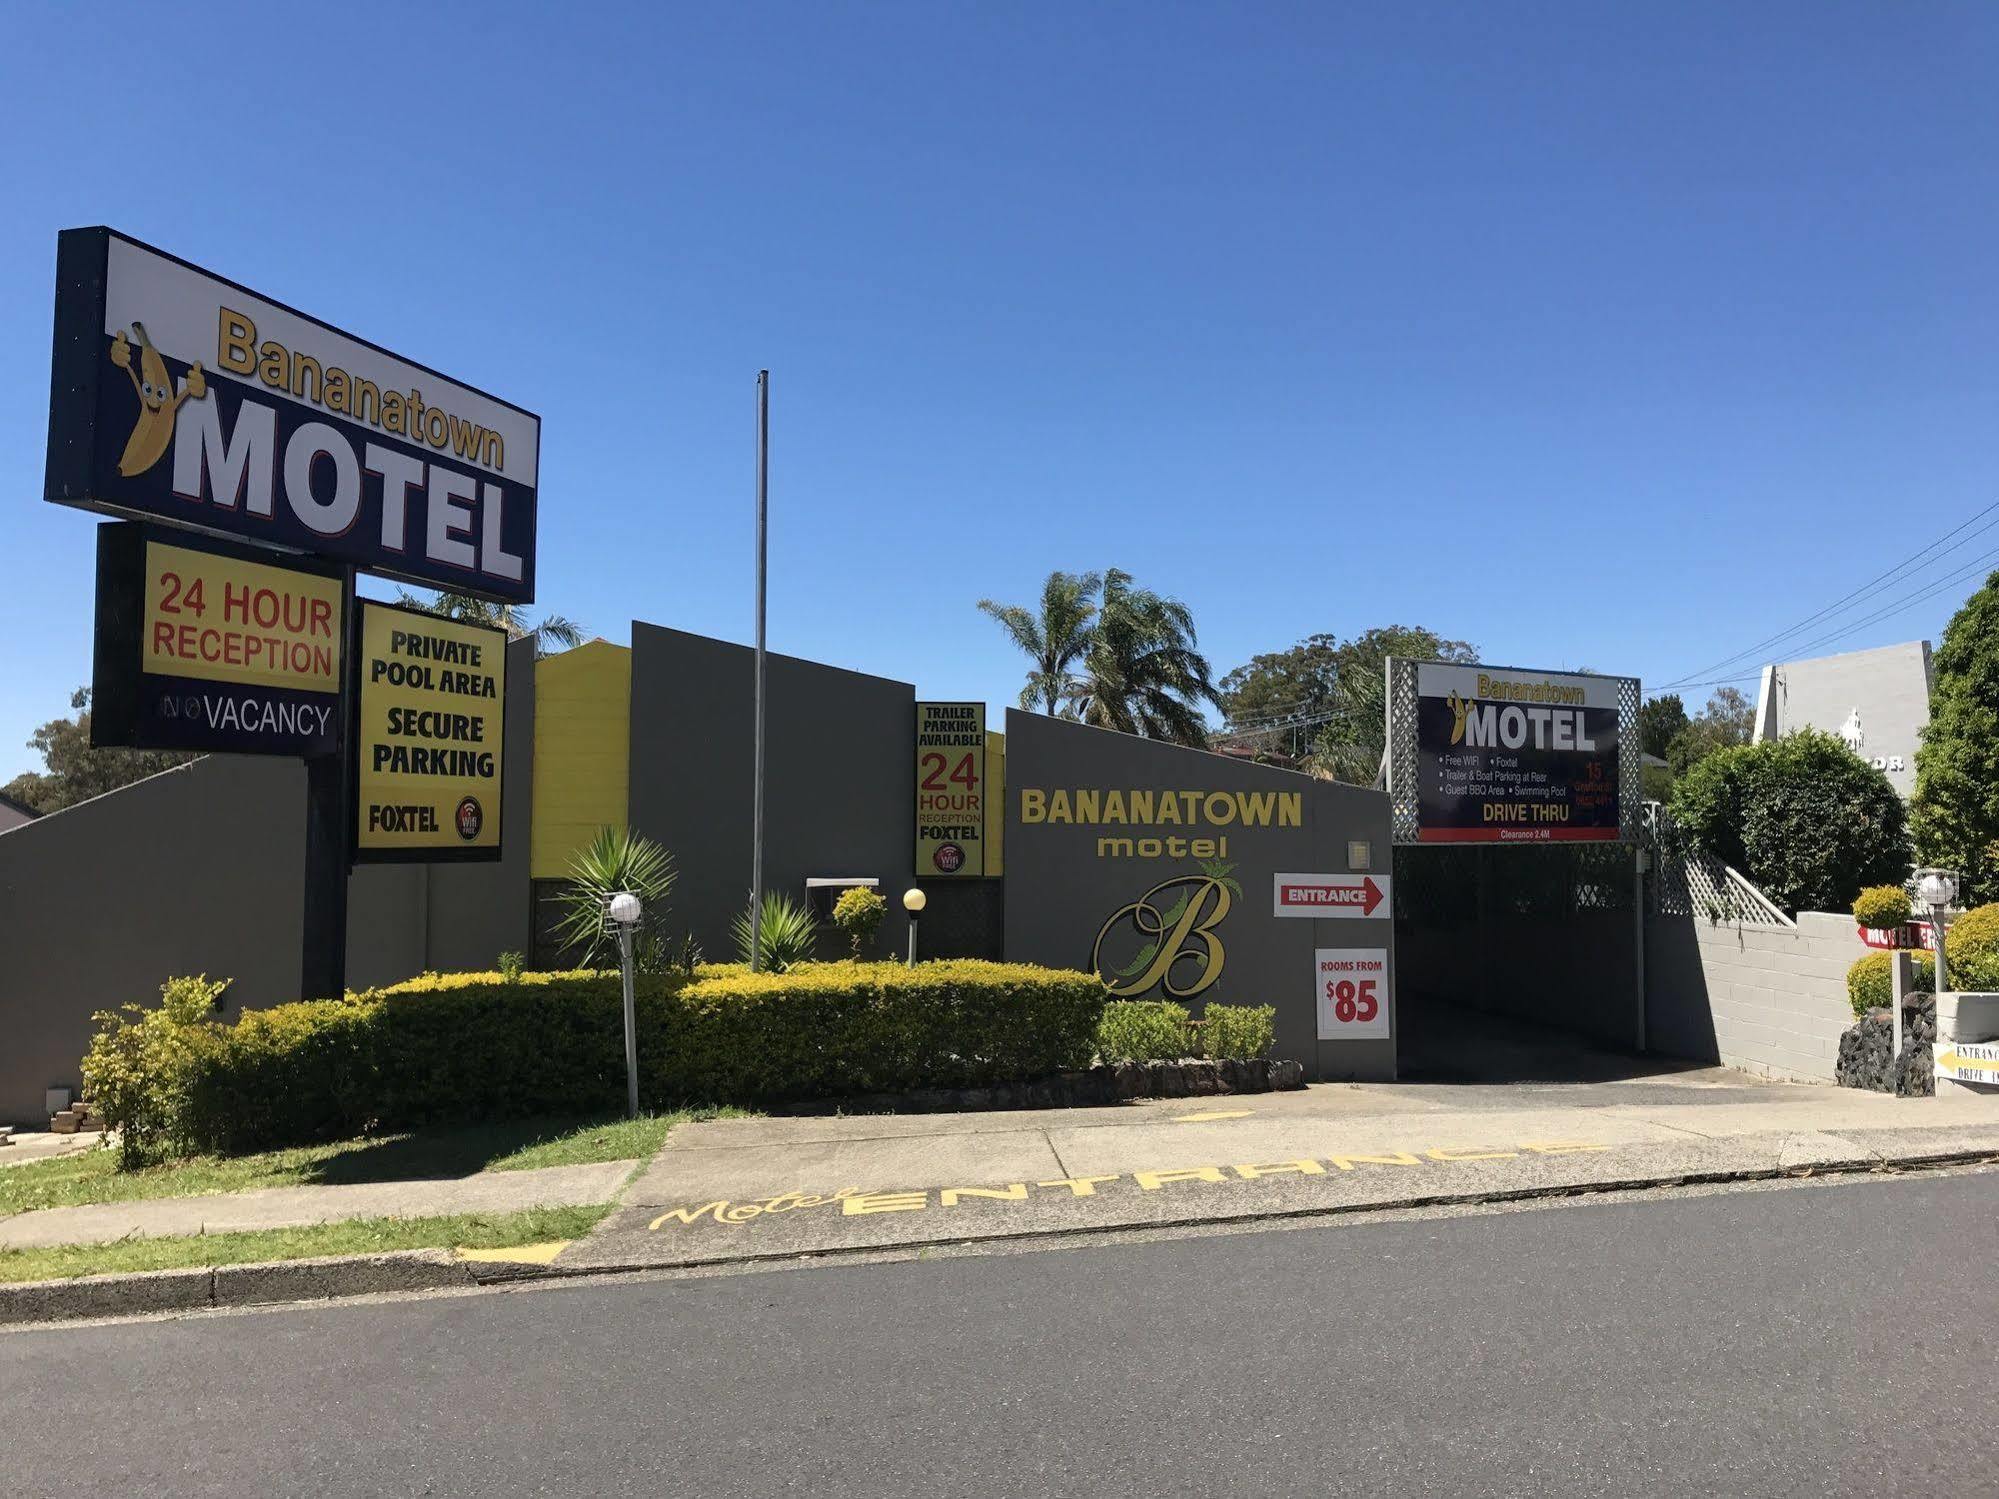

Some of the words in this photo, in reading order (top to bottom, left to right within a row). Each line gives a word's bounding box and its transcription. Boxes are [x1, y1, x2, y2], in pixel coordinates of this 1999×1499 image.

[217, 306, 505, 471] Bananatown
[172, 377, 523, 582] MOTEL
[160, 572, 206, 618] 24
[224, 581, 333, 639] HOUR
[153, 620, 332, 677] RECEPTION
[391, 630, 482, 667] PRIVATE
[371, 658, 434, 691] POOL
[439, 670, 497, 699] AREA
[1477, 674, 1586, 705] Bananatown
[203, 695, 331, 736] VACANCY
[387, 707, 484, 743] SECURE
[926, 707, 975, 718] TRAILER
[919, 734, 982, 746] AVAILABLE
[924, 721, 977, 732] PARKING
[1465, 703, 1596, 751] MOTEL
[373, 744, 495, 778] PARKING
[921, 752, 979, 791] 24
[1445, 755, 1462, 766] Free
[1496, 757, 1518, 767] Foxtel
[1445, 769, 1467, 780] Trailer
[1468, 770, 1475, 780] &
[1475, 770, 1494, 781] Boat
[1495, 771, 1521, 784] Parking
[1523, 772, 1530, 781] at
[1531, 772, 1547, 782] Rear
[920, 795, 979, 810] HOUR
[1445, 784, 1468, 795] Guest
[1469, 784, 1487, 796] BBQ
[1488, 785, 1505, 796] Area
[1514, 786, 1550, 798] Swimming
[1551, 786, 1566, 796] Pool
[369, 805, 439, 832] FOXTEL
[919, 814, 981, 823] RECEPTION
[1021, 788, 1301, 826] BANANATOWN
[1483, 803, 1527, 821] DRIVE
[1531, 804, 1569, 821] THRU
[920, 826, 979, 840] FOXTEL
[1097, 835, 1228, 858] motel
[1500, 829, 1534, 839] Clearance
[1535, 830, 1550, 839] 2.4M
[1288, 888, 1367, 903] ENTRANCE
[1321, 961, 1354, 971] ROOMS
[1356, 961, 1383, 971] FROM
[1326, 980, 1379, 1022] $85
[1958, 1066, 1985, 1081] DRIVE
[649, 1186, 881, 1230] Motel
[842, 1142, 1614, 1216] ENTRANCE
